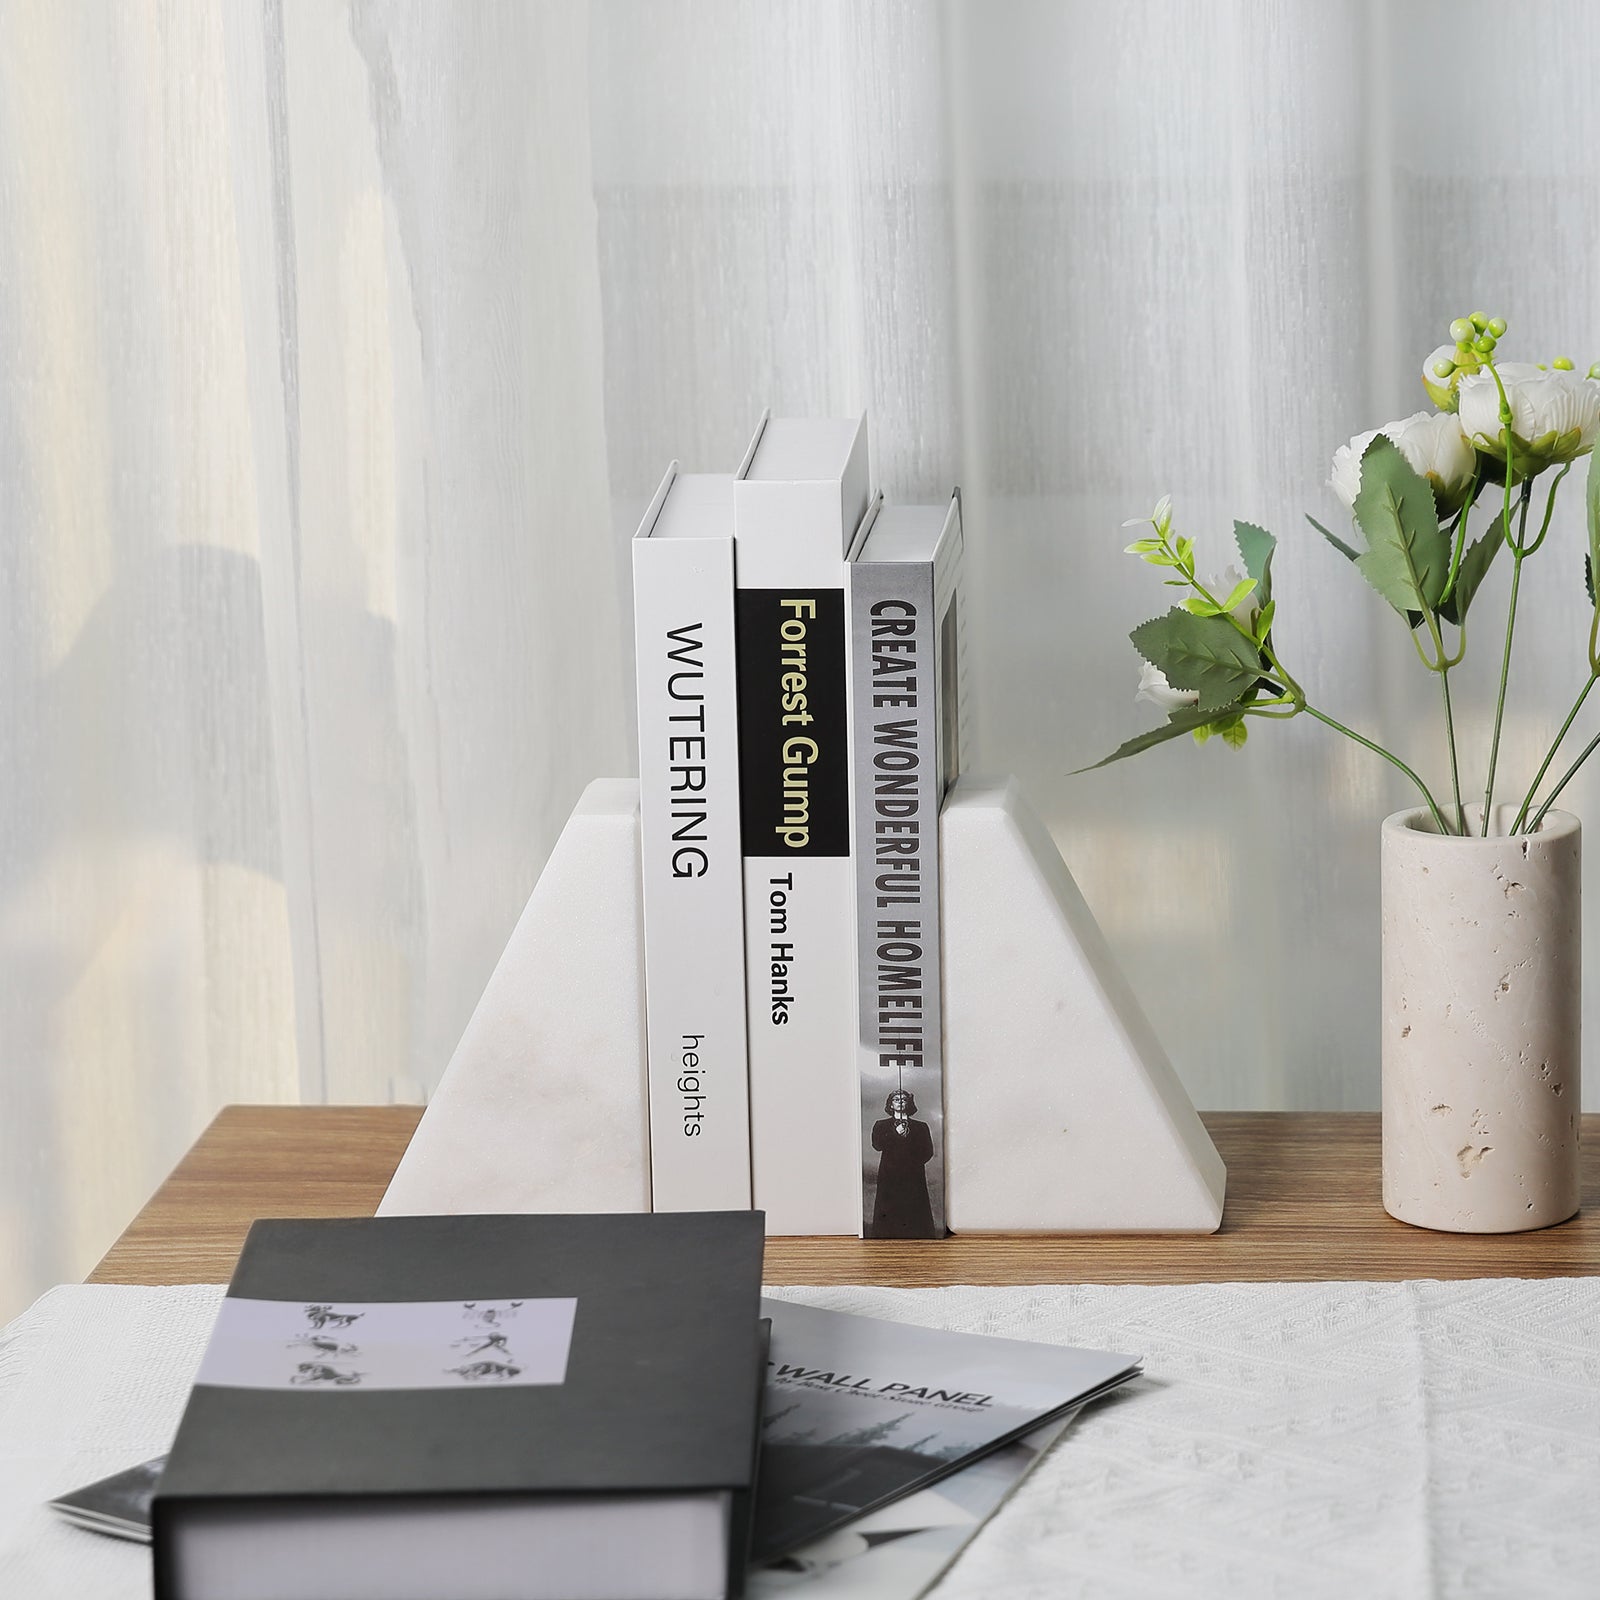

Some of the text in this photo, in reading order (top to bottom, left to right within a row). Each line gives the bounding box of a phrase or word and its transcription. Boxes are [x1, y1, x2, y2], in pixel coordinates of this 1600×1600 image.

[666, 622, 709, 878] WUTERING
[775, 599, 819, 848] Forrest Gump
[869, 599, 924, 1068] CREATE WONDERFUL HOMELIFE
[769, 872, 795, 1026] Tom Hanks
[676, 1034, 707, 1137] heights
[776, 1363, 994, 1408] WALL PANEL
